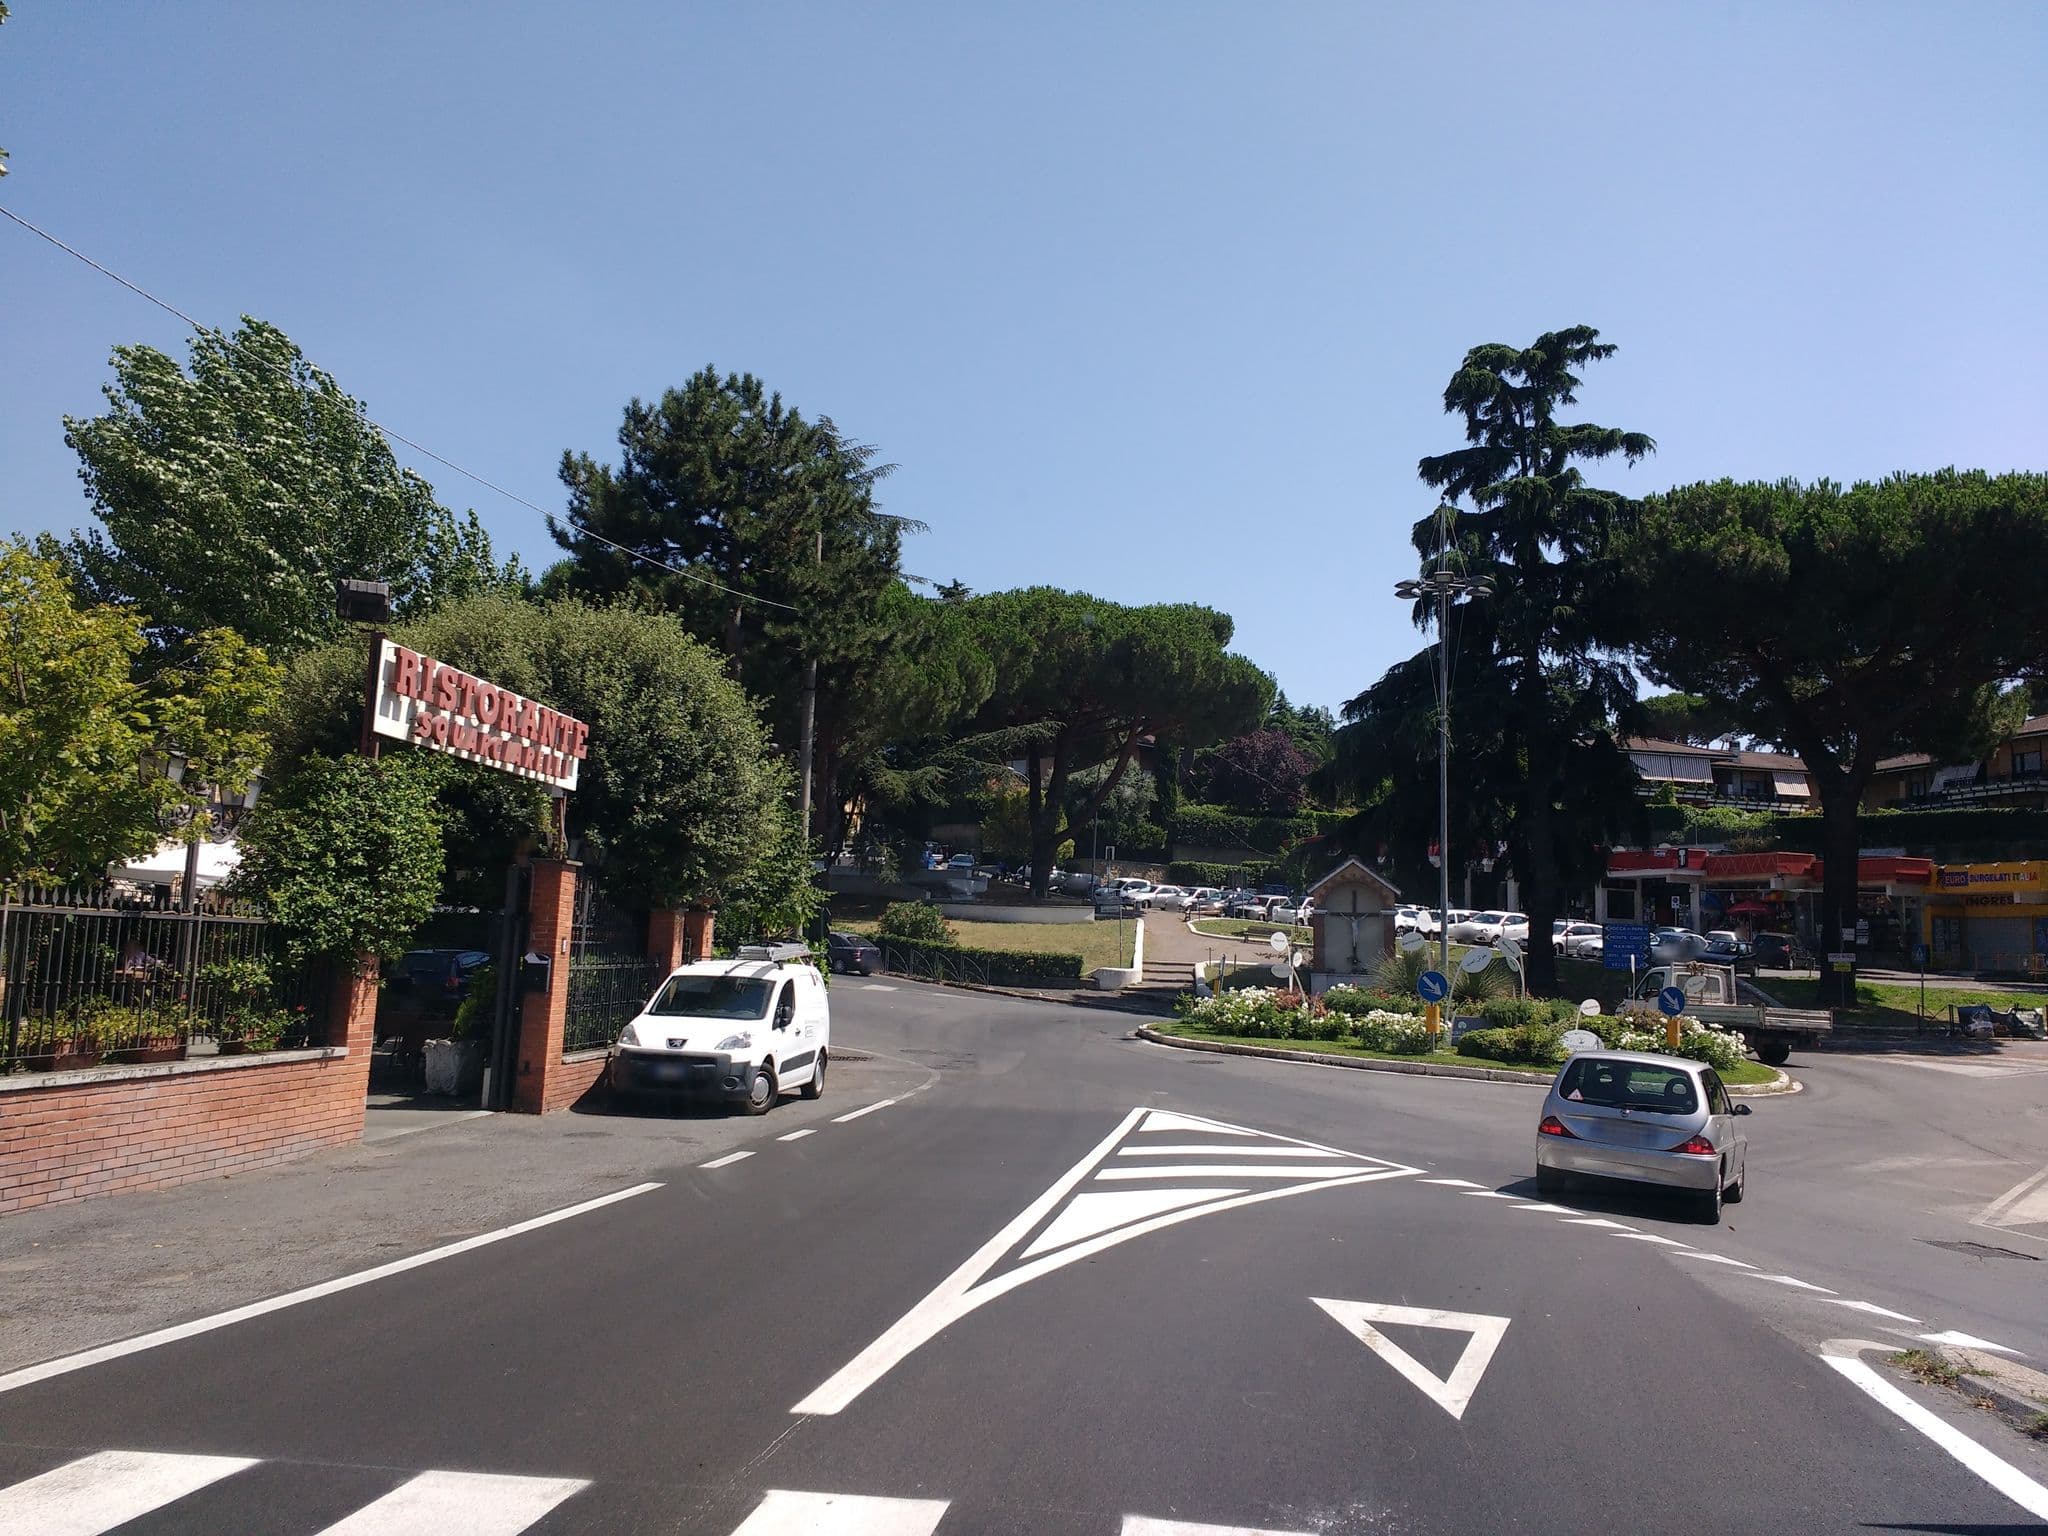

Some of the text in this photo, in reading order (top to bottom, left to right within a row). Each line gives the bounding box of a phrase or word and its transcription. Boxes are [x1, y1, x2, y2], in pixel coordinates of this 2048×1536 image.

[393, 646, 590, 760] RISTORANTE
[414, 711, 570, 780] SQUARCIARELLI
[1944, 875, 1966, 885] EURO
[2012, 872, 2039, 882] ITALIA
